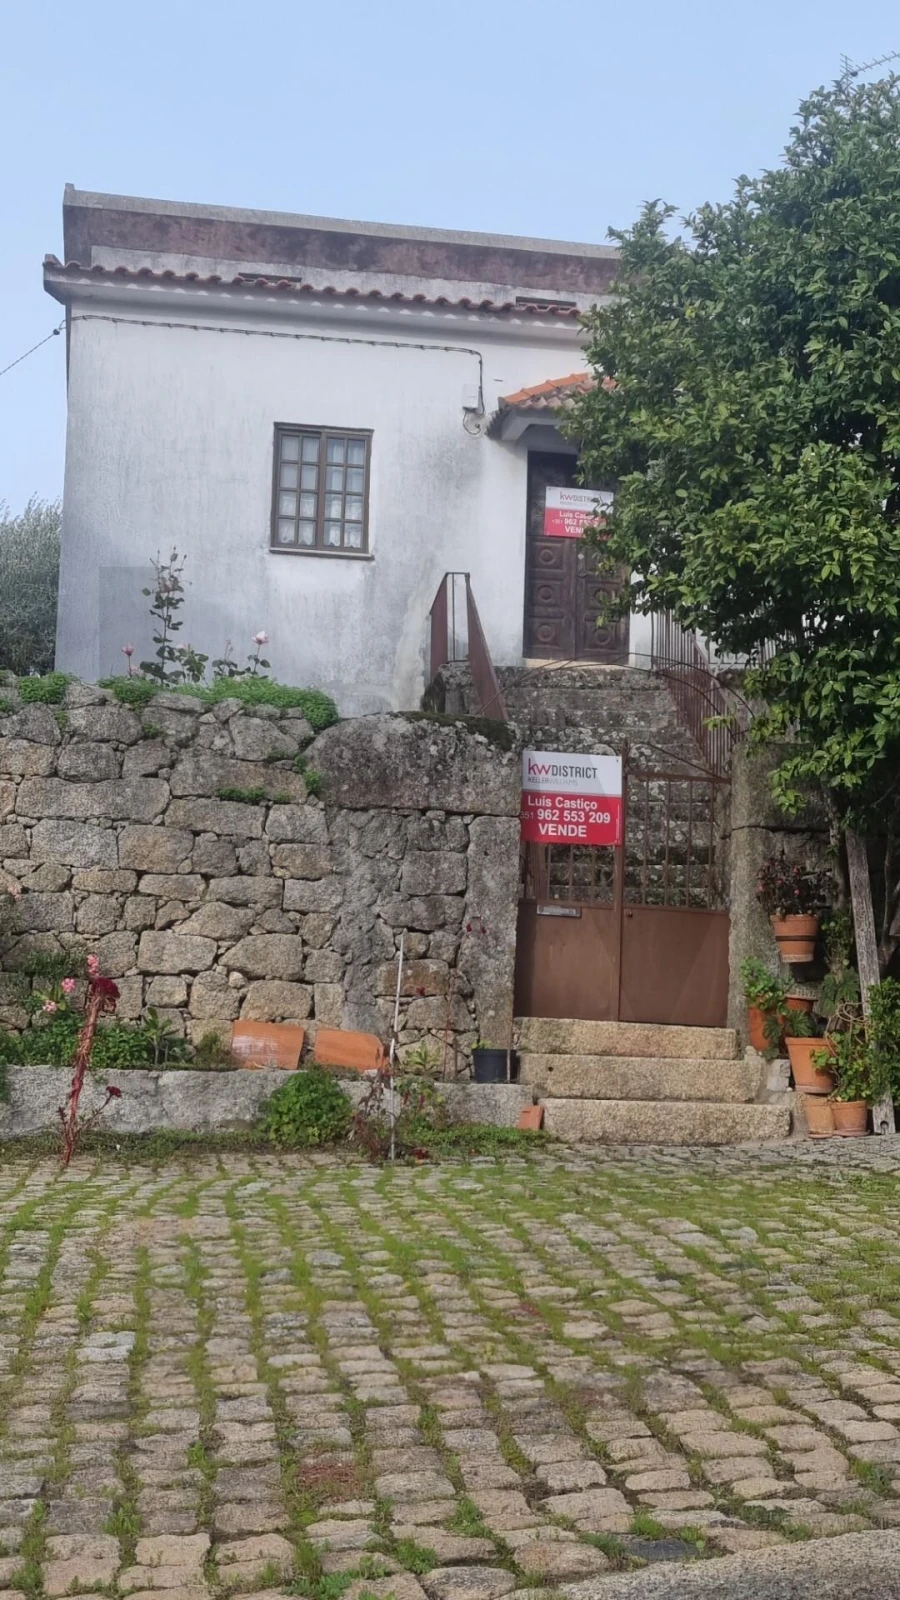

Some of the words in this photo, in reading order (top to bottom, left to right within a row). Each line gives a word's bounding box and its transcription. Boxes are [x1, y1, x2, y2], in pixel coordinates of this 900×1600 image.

[560, 491, 596, 502] kwDISTR
[564, 518, 577, 526] 962
[565, 525, 584, 534] VEN
[555, 796, 598, 812] Castiço
[537, 808, 560, 821] 962
[563, 810, 585, 822] 553
[588, 811, 611, 824] 209
[538, 822, 588, 838] VENDE
